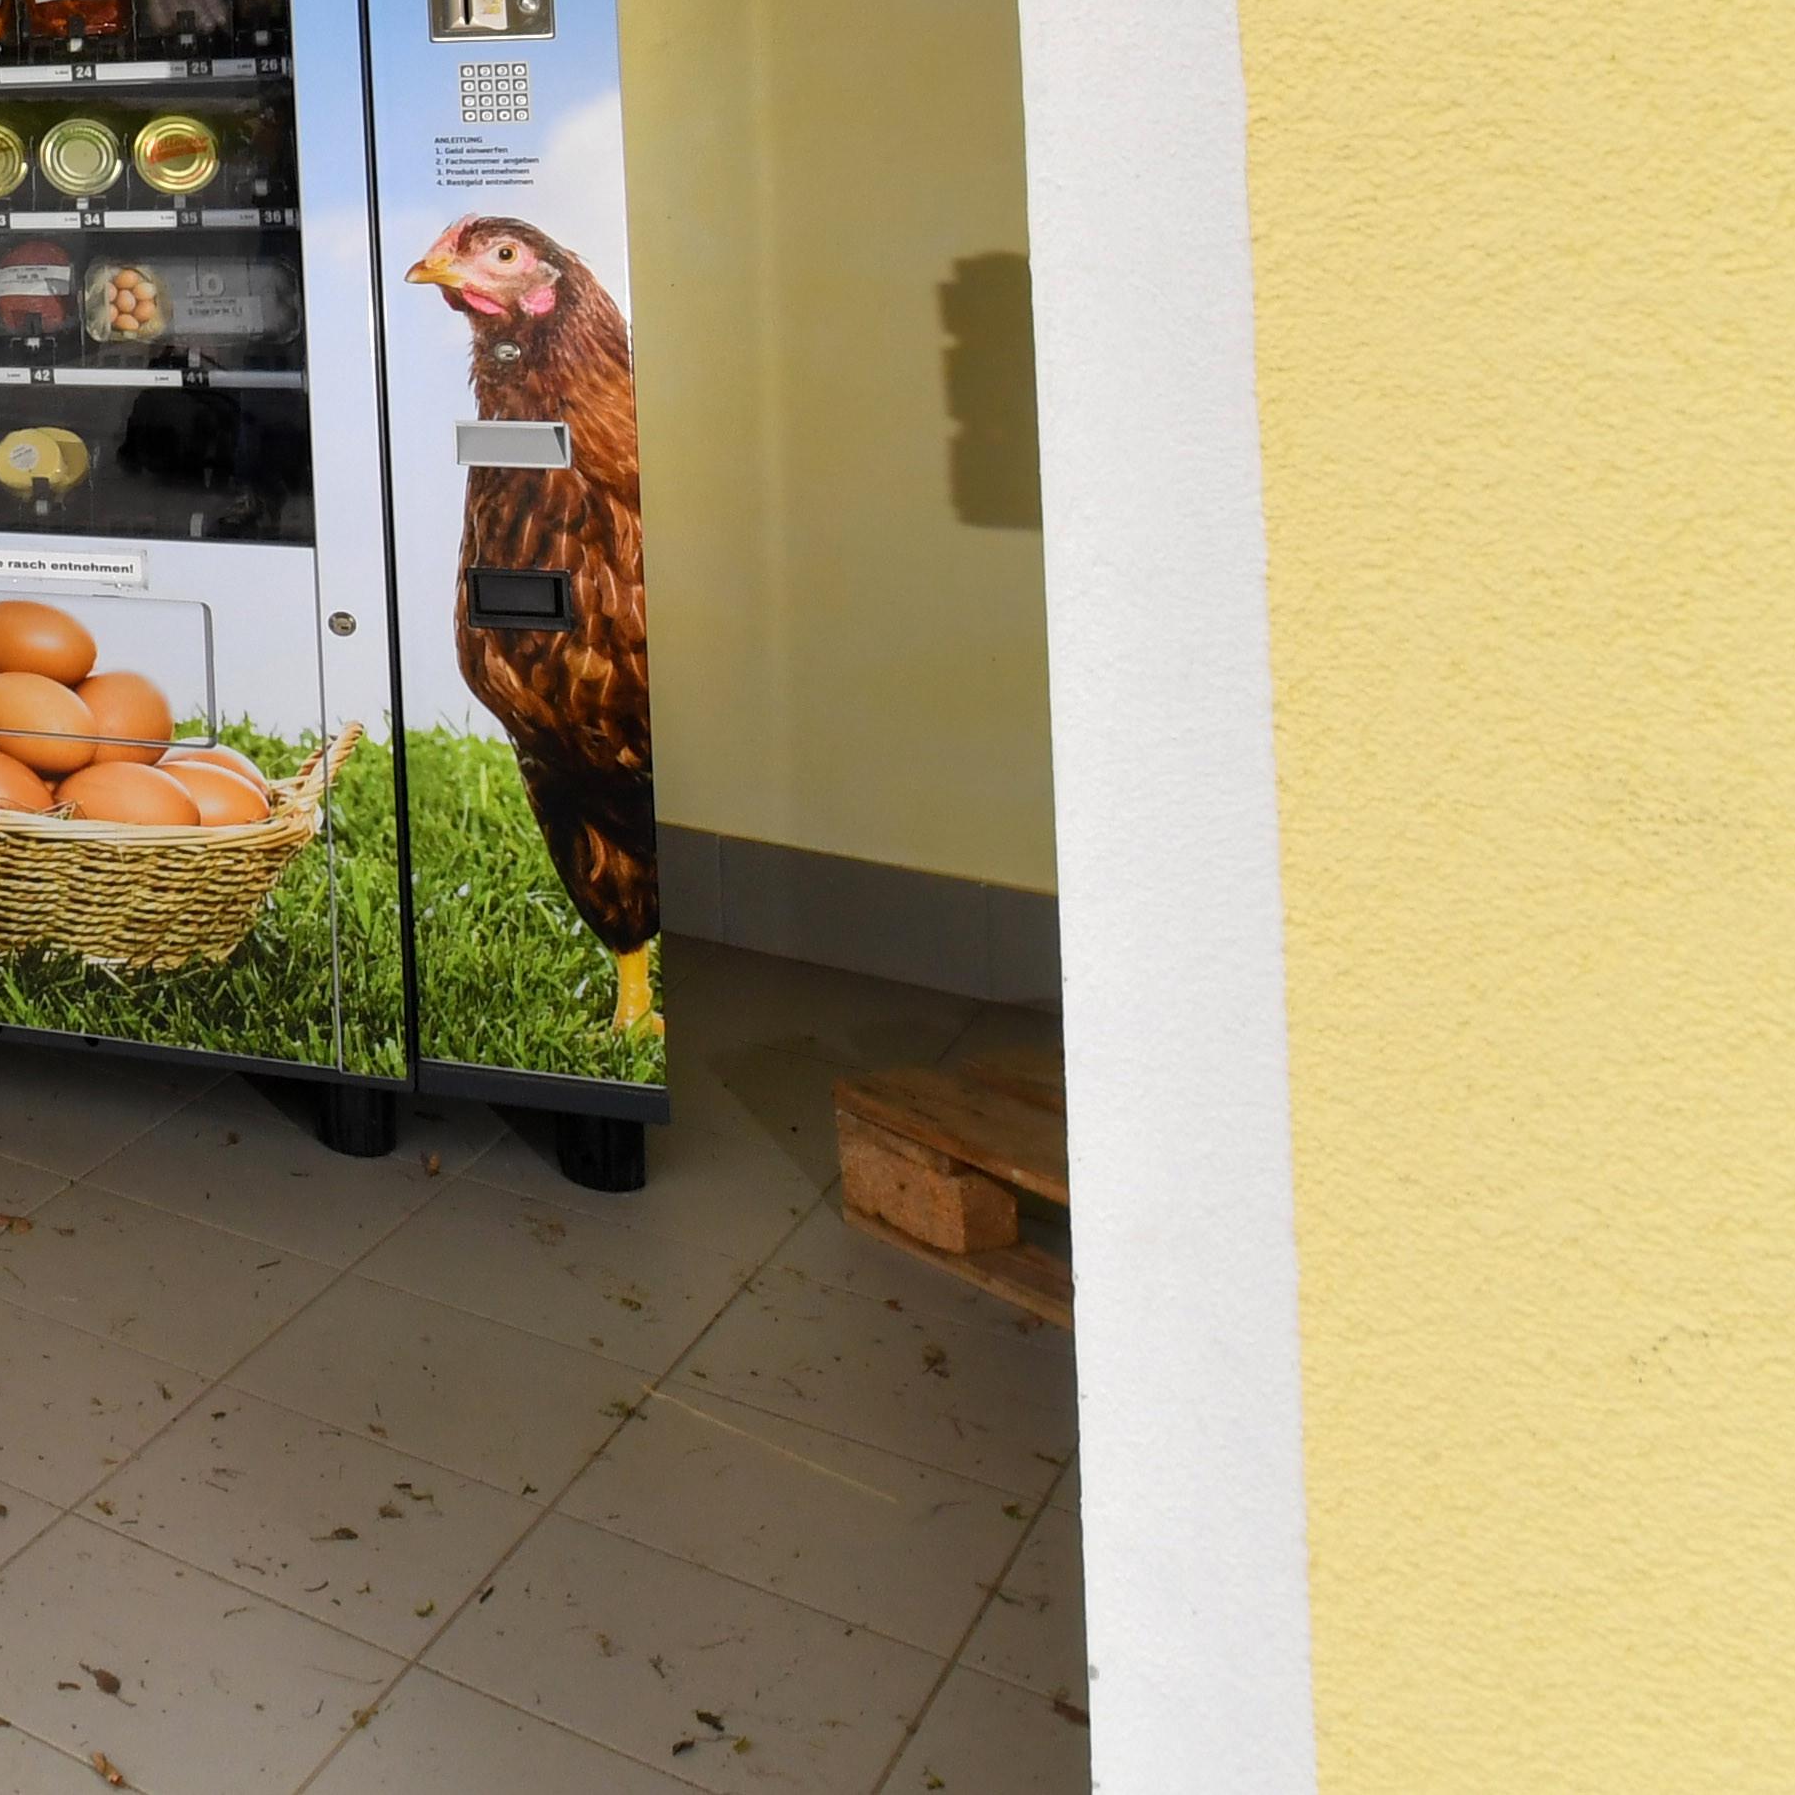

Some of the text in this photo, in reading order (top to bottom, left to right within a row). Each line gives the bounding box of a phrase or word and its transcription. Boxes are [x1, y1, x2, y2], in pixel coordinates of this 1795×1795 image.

[75, 66, 92, 78] 24
[191, 62, 208, 74] 25
[261, 59, 277, 71] 26
[434, 136, 483, 144] ANLEITUNG
[466, 146, 508, 154] einwerfen
[446, 179, 483, 187] Restgeld
[485, 178, 534, 186] entnehmen
[84, 213, 101, 225] 34
[181, 211, 198, 224] 35
[265, 210, 281, 223] 36
[187, 273, 226, 298] 10
[34, 370, 51, 381] 42
[8, 559, 47, 570] rasch
[51, 561, 134, 574] entnehmen!
